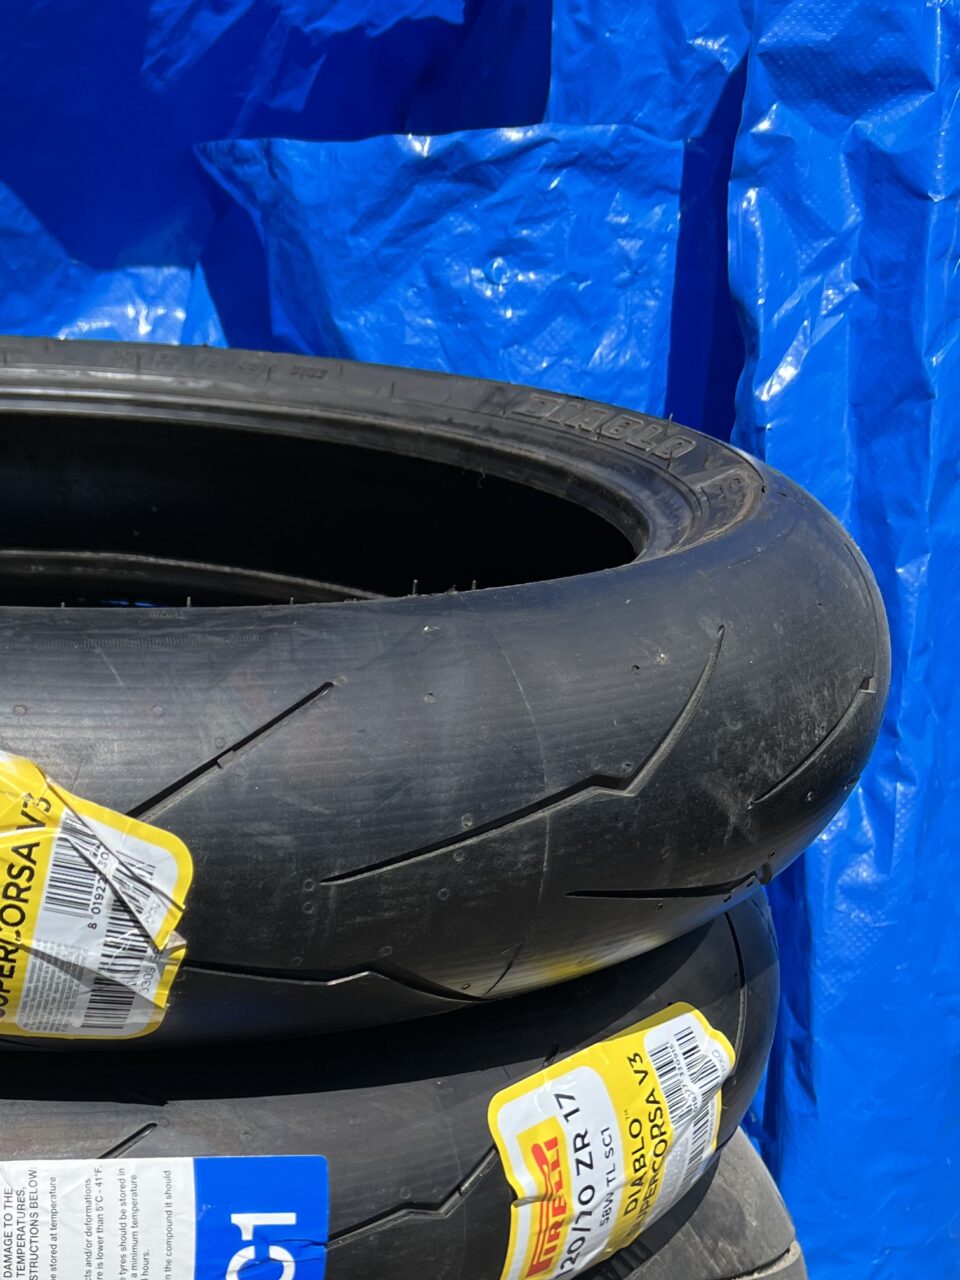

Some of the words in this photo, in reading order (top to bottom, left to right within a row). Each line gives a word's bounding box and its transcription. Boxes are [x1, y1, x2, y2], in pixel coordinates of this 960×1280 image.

[512, 393, 696, 460] DIABLO
[627, 1052, 648, 1085] V3
[554, 1093, 580, 1123] 17
[573, 1129, 593, 1176] ZR
[600, 1127, 614, 1158] SC1
[628, 1088, 668, 1224] UPERCORSA
[28, 1167, 38, 1208] BELOW:
[117, 1168, 125, 1176] in
[163, 1170, 172, 1200] should
[606, 1163, 616, 1187] TL
[3, 1188, 12, 1210] THE
[49, 1176, 58, 1230] temperature
[84, 1178, 92, 1236] deformations
[118, 1178, 126, 1207] stored
[130, 1175, 139, 1229] temperature
[528, 1137, 566, 1276] PIRELLI
[3, 1213, 12, 1227] TO
[96, 1214, 104, 1233] than
[119, 1209, 126, 1220] be
[599, 1192, 614, 1226] 58W
[16, 1186, 26, 1277] TEMPERATURES,
[50, 1233, 57, 1241] at
[164, 1210, 174, 1256] compound
[554, 1185, 595, 1278] 120/70
[4, 1231, 12, 1278] DAMAGE
[84, 1238, 92, 1267] and/or
[96, 1236, 104, 1260] lower
[130, 1231, 138, 1270] minimum
[141, 1249, 149, 1276] hours.
[119, 1254, 128, 1275] tyres
[164, 1259, 172, 1272] the
